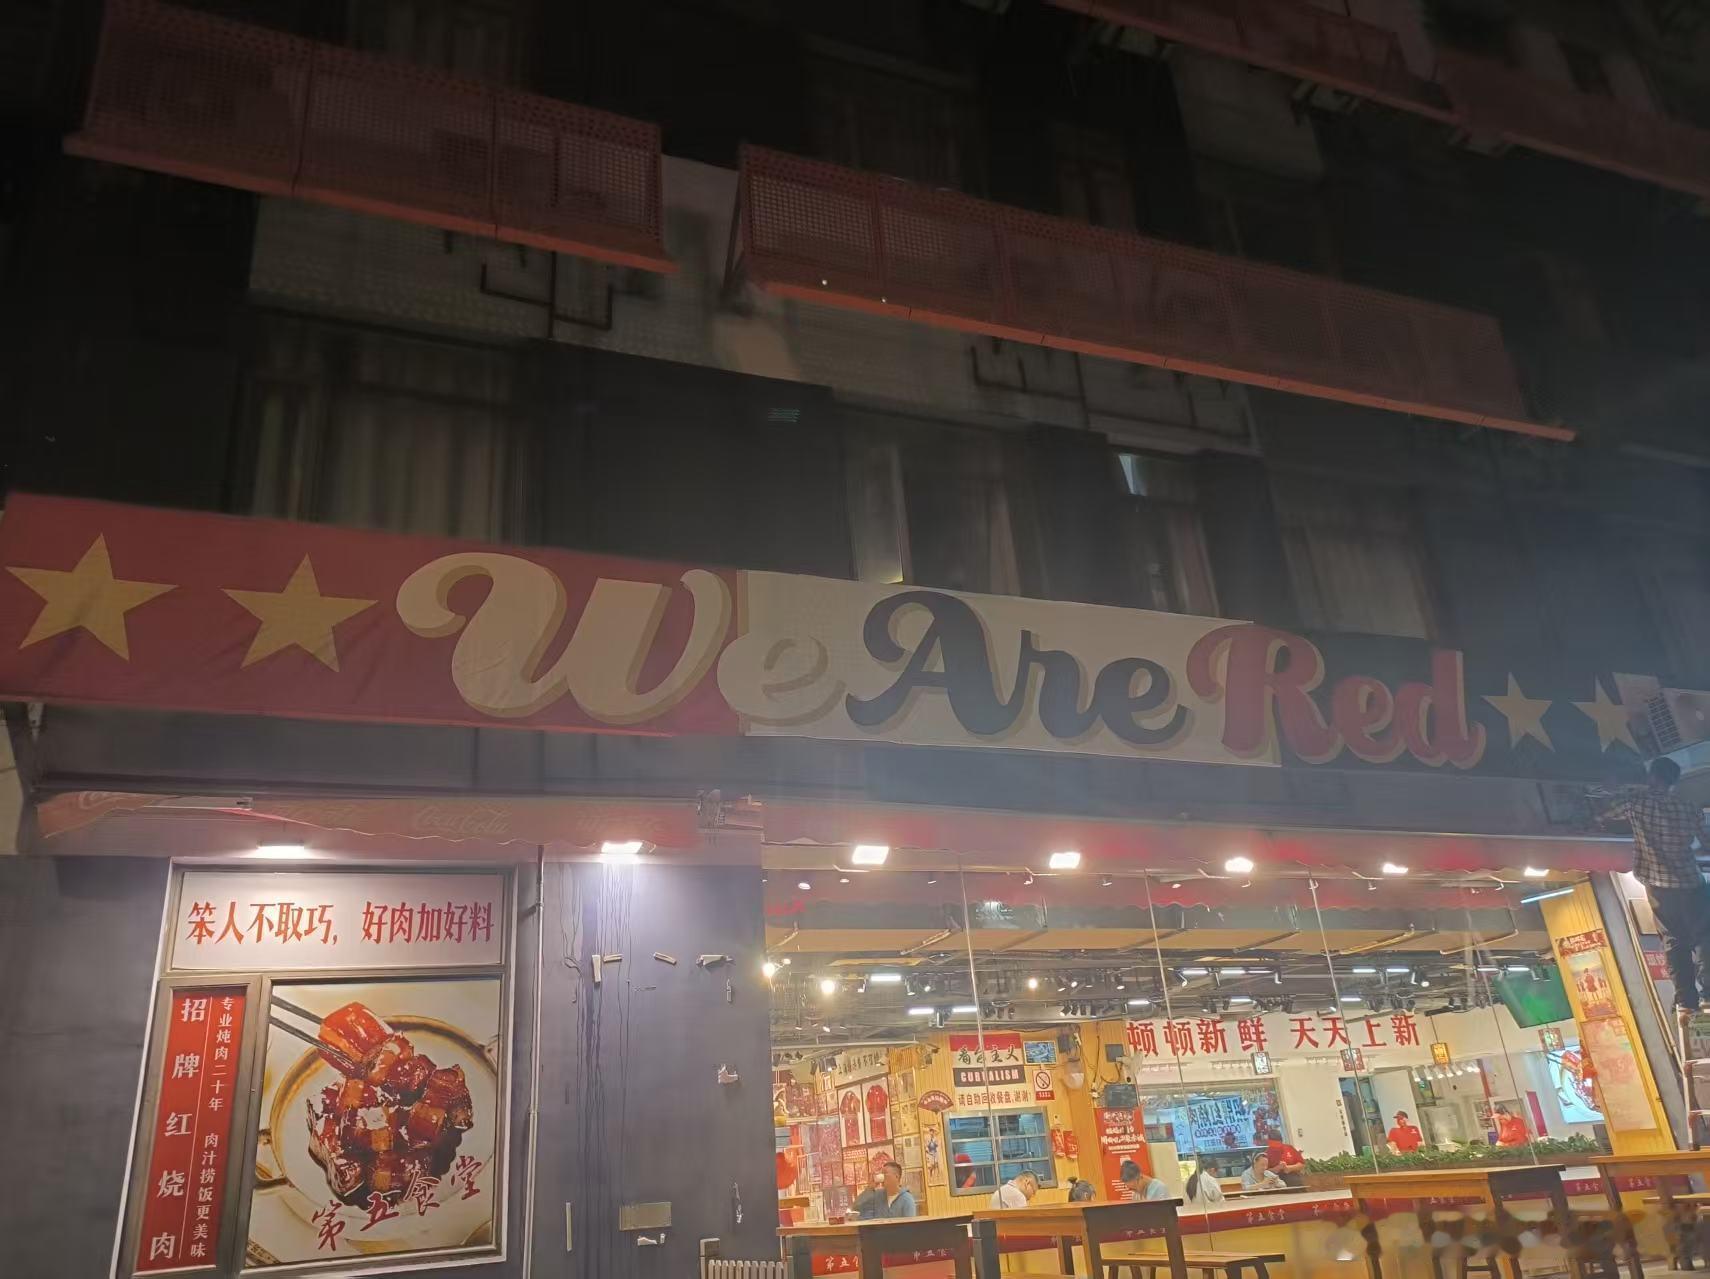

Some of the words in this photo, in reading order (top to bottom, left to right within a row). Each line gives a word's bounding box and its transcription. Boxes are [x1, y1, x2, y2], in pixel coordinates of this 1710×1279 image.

[396, 552, 848, 725] We
[846, 590, 1195, 749] Are
[1186, 624, 1487, 770] Red
[1126, 1015, 1268, 1058] 顿顿新鲜
[1289, 1014, 1421, 1049] 天天上新
[150, 998, 207, 1261] 招牌红烧肉
[311, 1155, 483, 1251] 第五食堂
